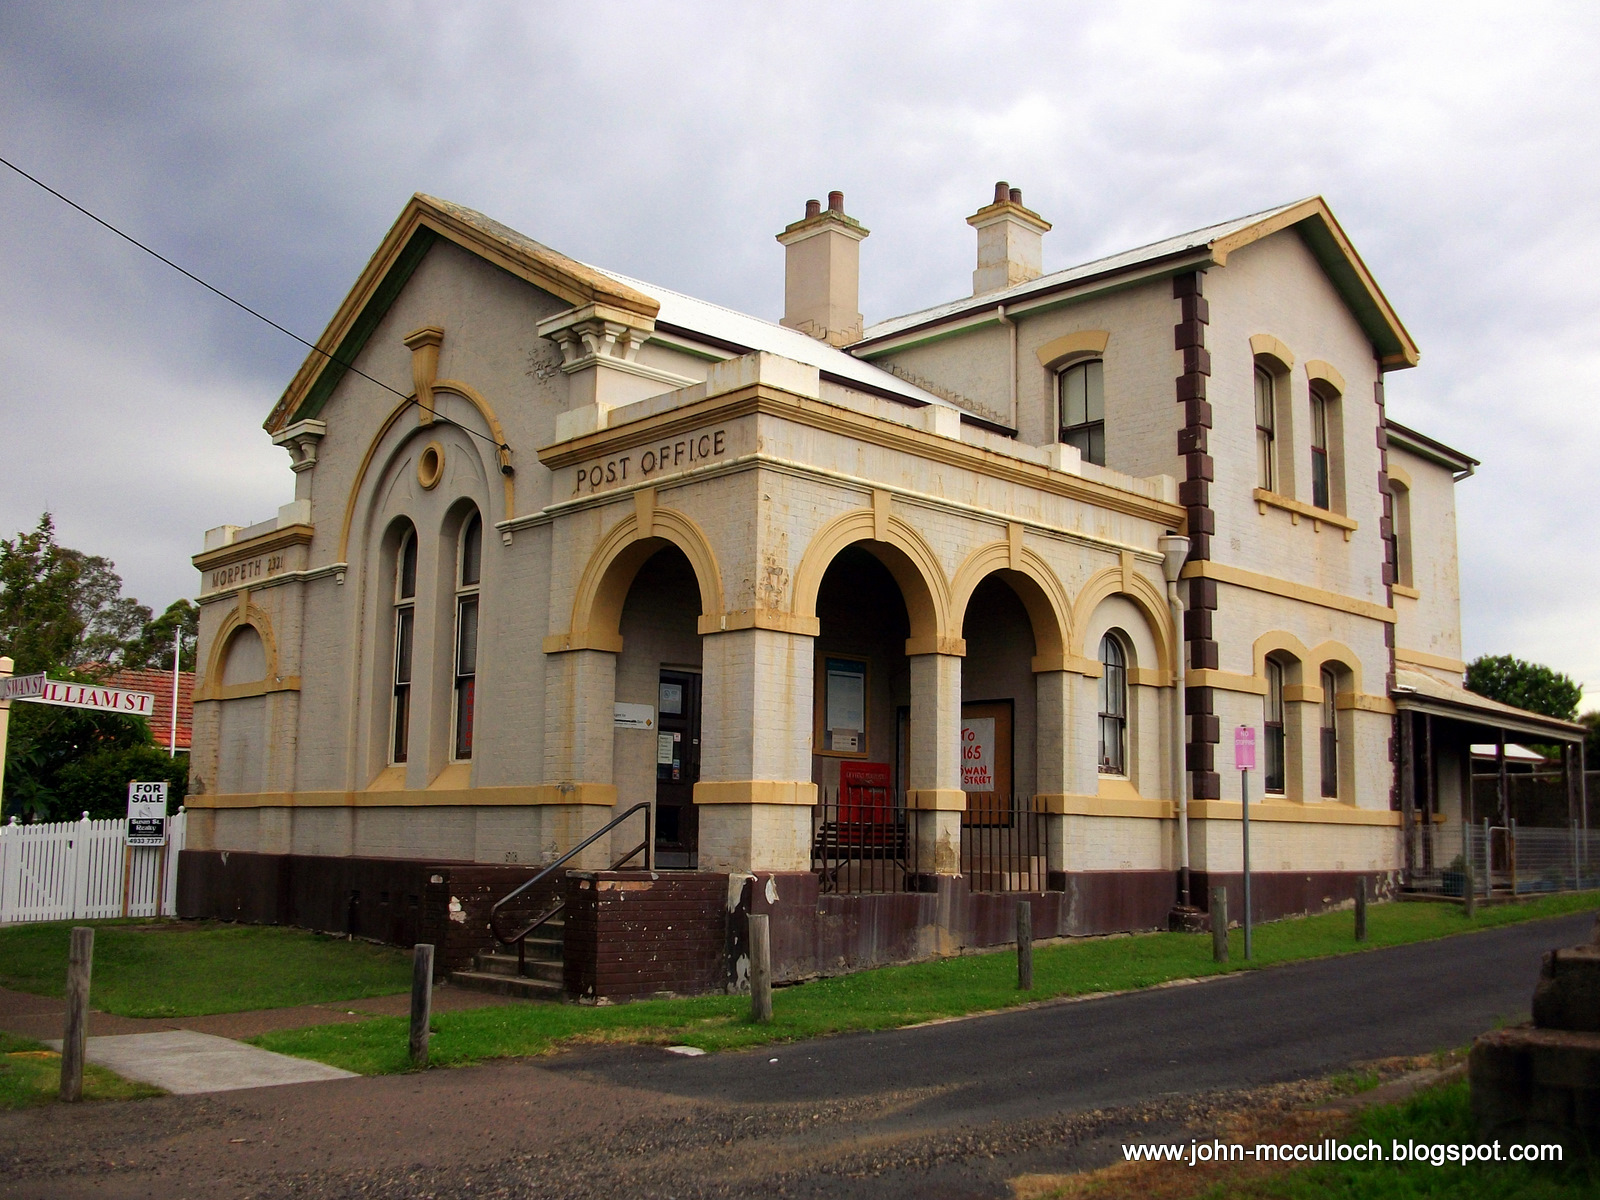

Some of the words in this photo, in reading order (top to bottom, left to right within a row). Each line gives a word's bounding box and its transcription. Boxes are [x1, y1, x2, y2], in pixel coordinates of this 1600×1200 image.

[576, 456, 630, 492] POST
[641, 429, 726, 475] OFFICE
[211, 559, 262, 588] MORPETH
[6, 677, 31, 697] SWAN
[32, 675, 45, 694] ST
[42, 683, 120, 708] ILLIAM
[124, 693, 150, 711] ST
[961, 727, 975, 741] TO
[963, 744, 982, 760] 165
[963, 775, 992, 785] STREET
[136, 784, 161, 793] FOR
[132, 794, 164, 803] SALE
